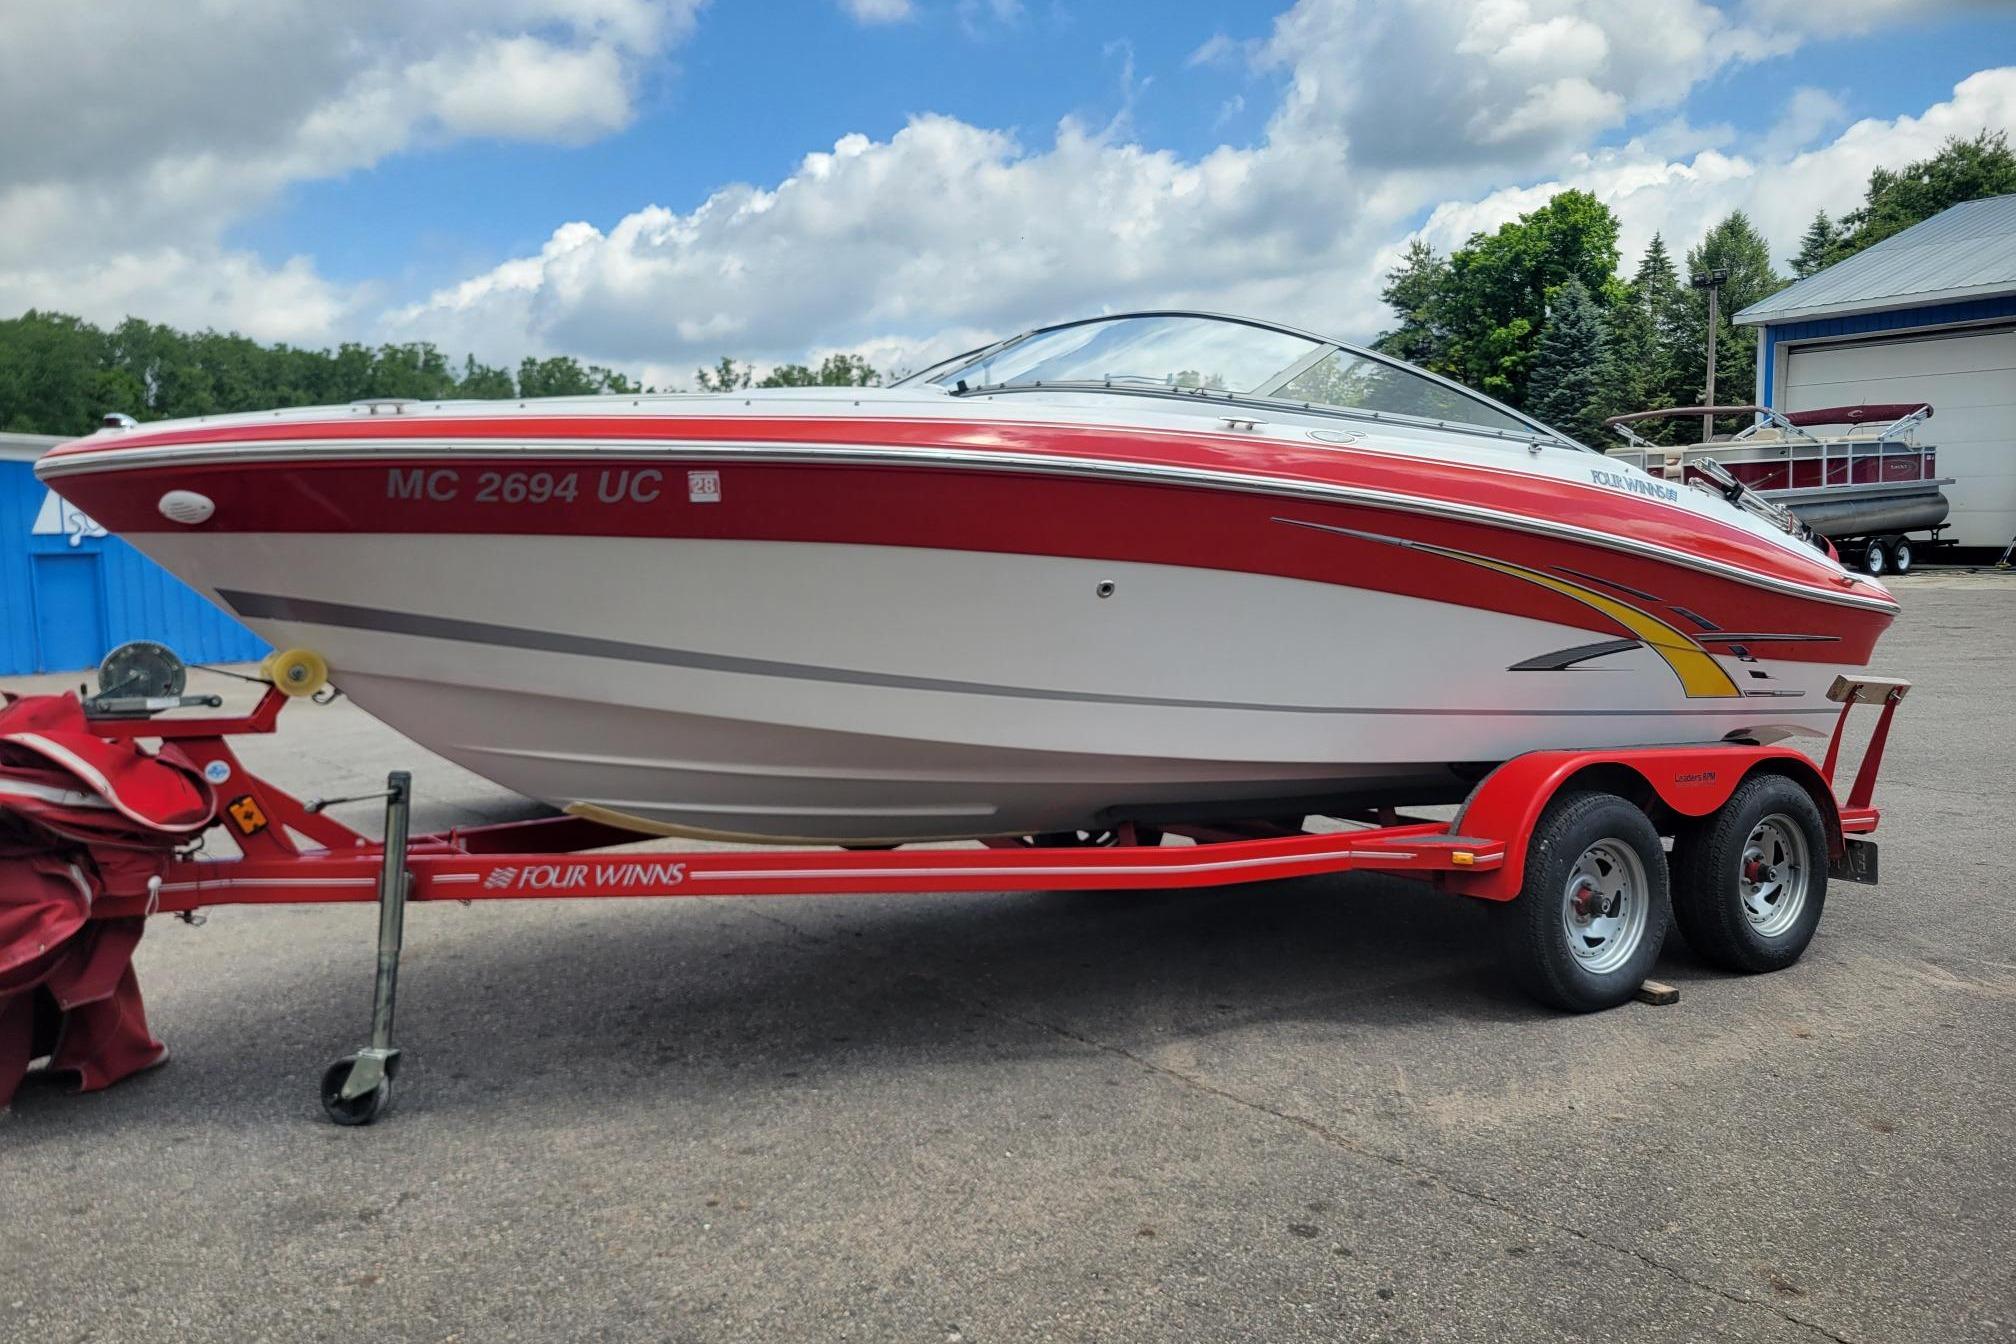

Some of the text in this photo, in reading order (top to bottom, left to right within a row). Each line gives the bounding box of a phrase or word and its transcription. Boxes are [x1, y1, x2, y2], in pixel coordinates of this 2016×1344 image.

[387, 469, 663, 503] MC 2694 UC
[1591, 470, 1665, 498] FOUR WINNS
[518, 863, 686, 889] FOUR WINNS
